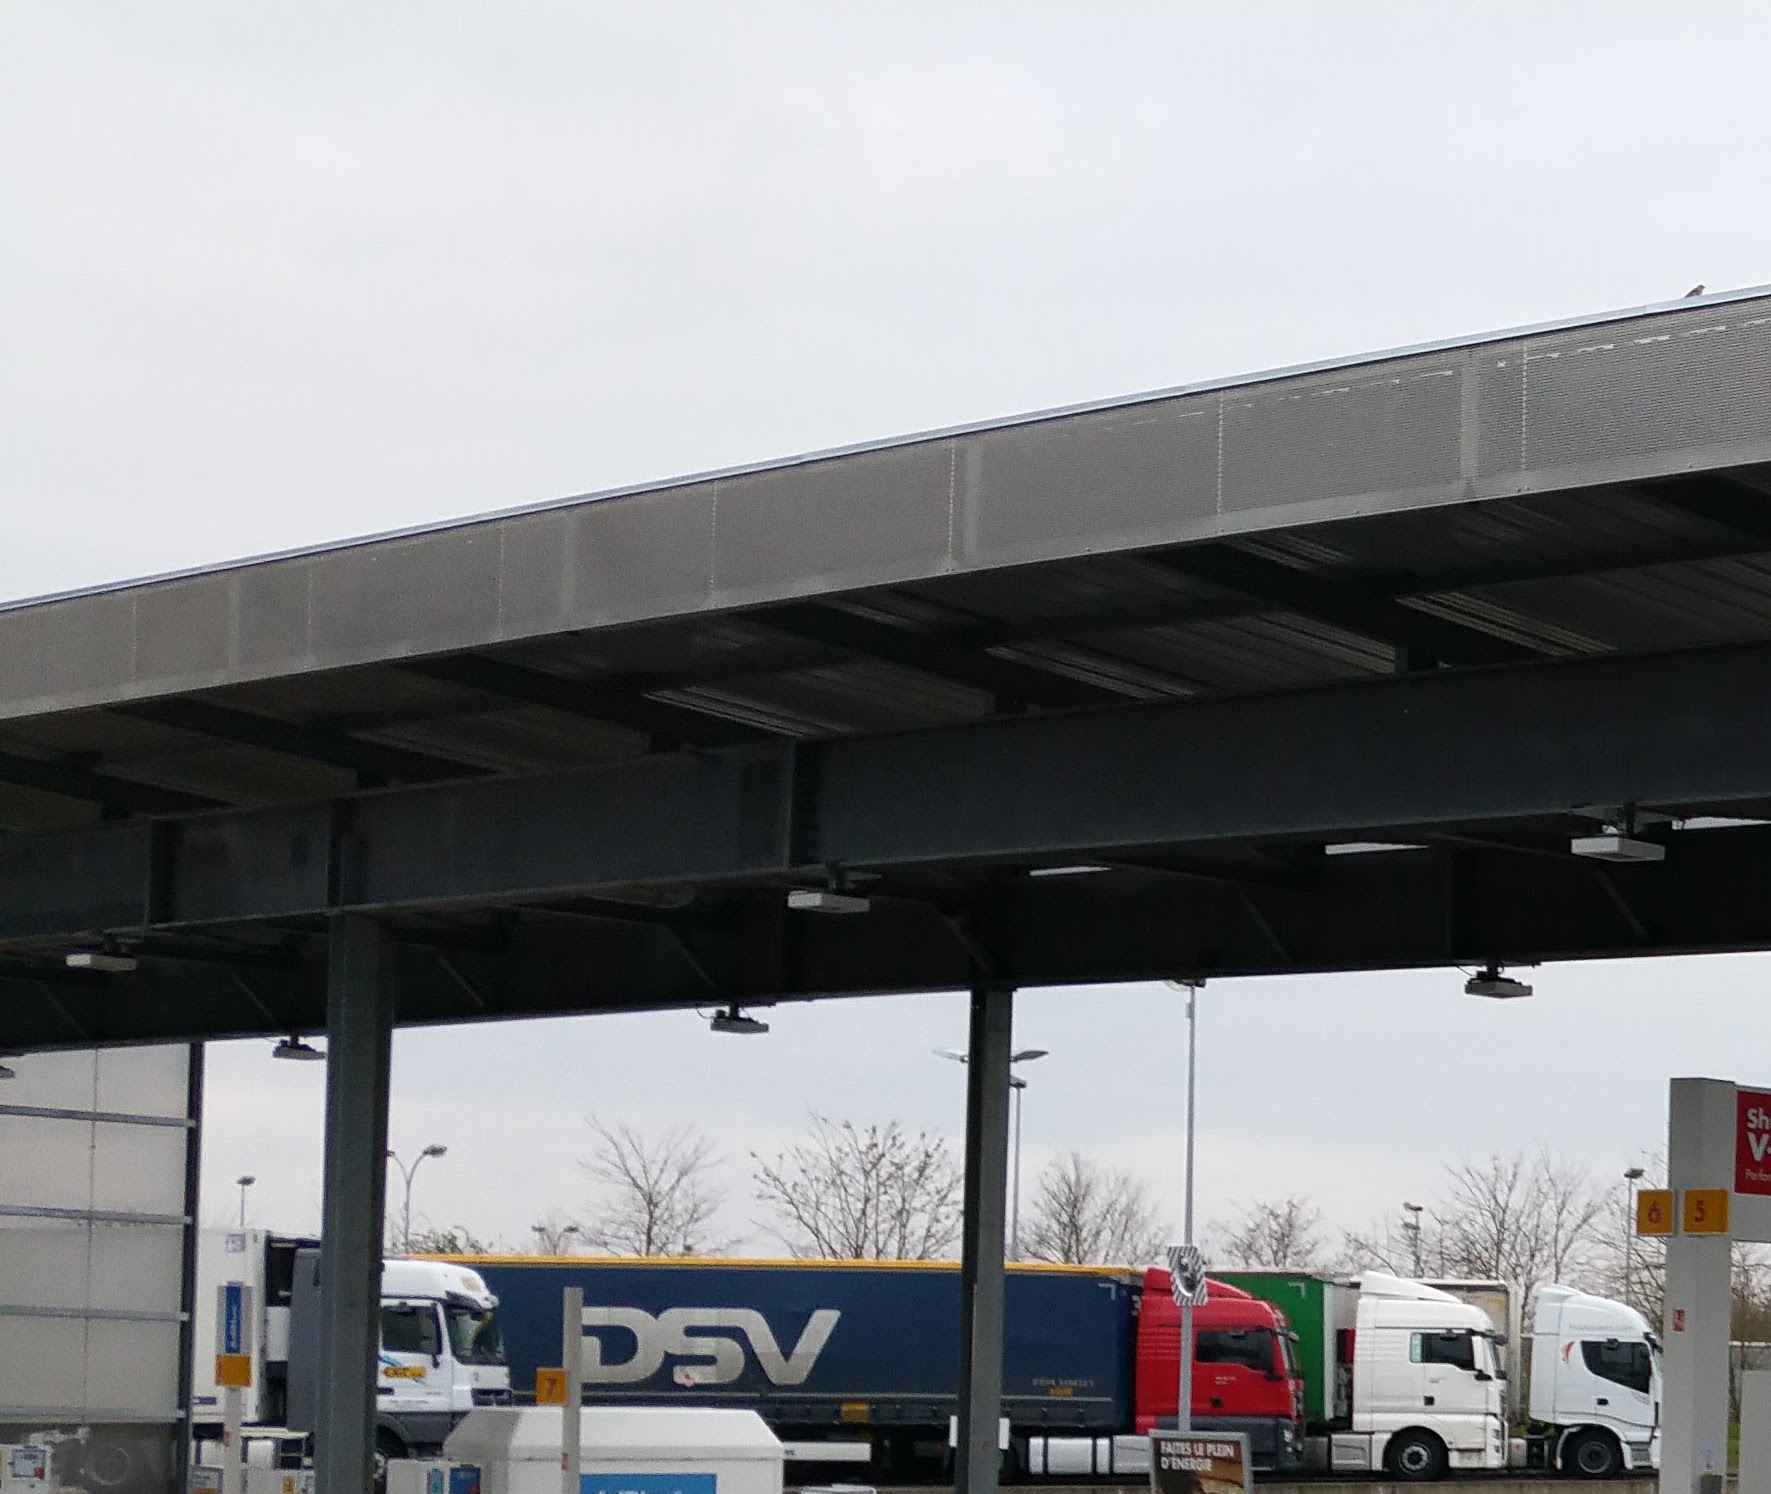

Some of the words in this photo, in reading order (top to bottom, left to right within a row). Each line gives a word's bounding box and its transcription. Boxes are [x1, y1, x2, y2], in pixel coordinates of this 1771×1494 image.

[1647, 1200, 1662, 1225] 6
[1693, 1198, 1706, 1223] 5
[581, 1306, 843, 1386] DSV
[1160, 1440, 1192, 1456] FAITES
[1206, 1441, 1235, 1458] PLEIN
